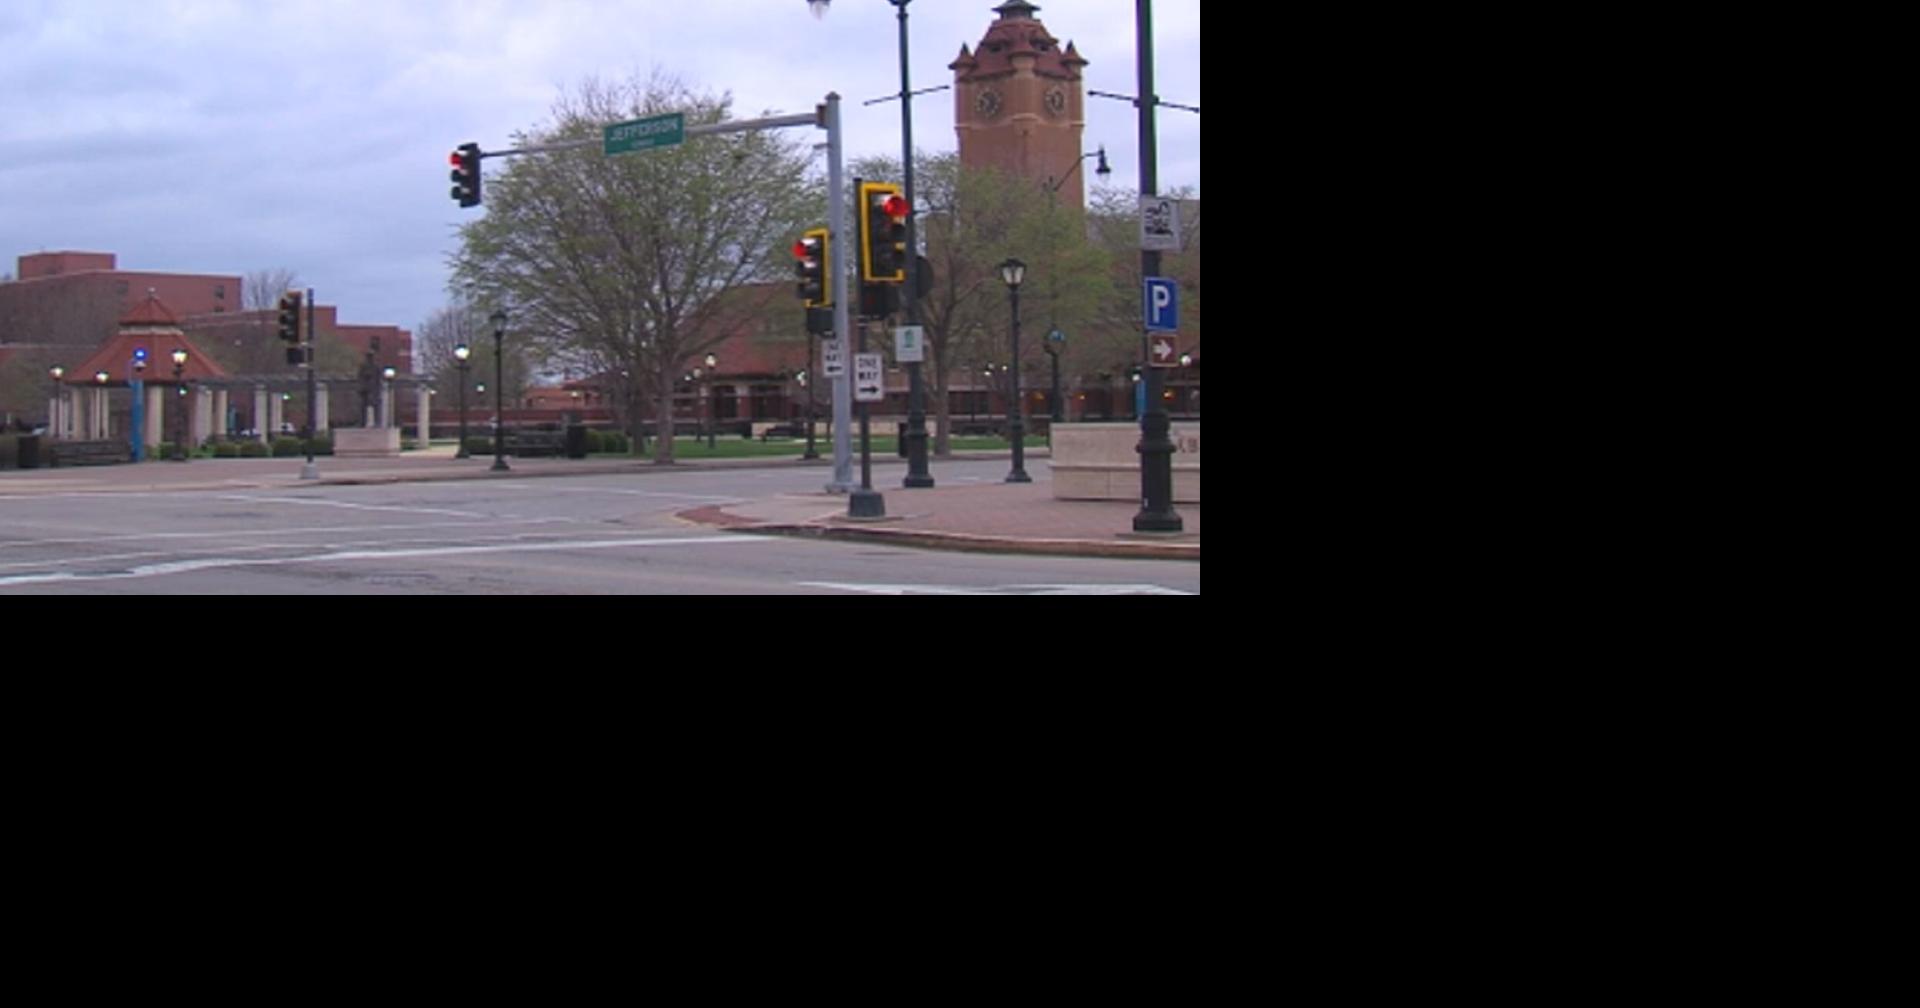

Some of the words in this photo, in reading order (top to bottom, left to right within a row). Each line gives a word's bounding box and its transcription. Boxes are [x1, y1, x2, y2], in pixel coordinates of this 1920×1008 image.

[609, 117, 679, 141] JEFFERSON
[1152, 285, 1170, 324] P
[858, 357, 877, 368] ONE
[858, 371, 879, 381] WAY
